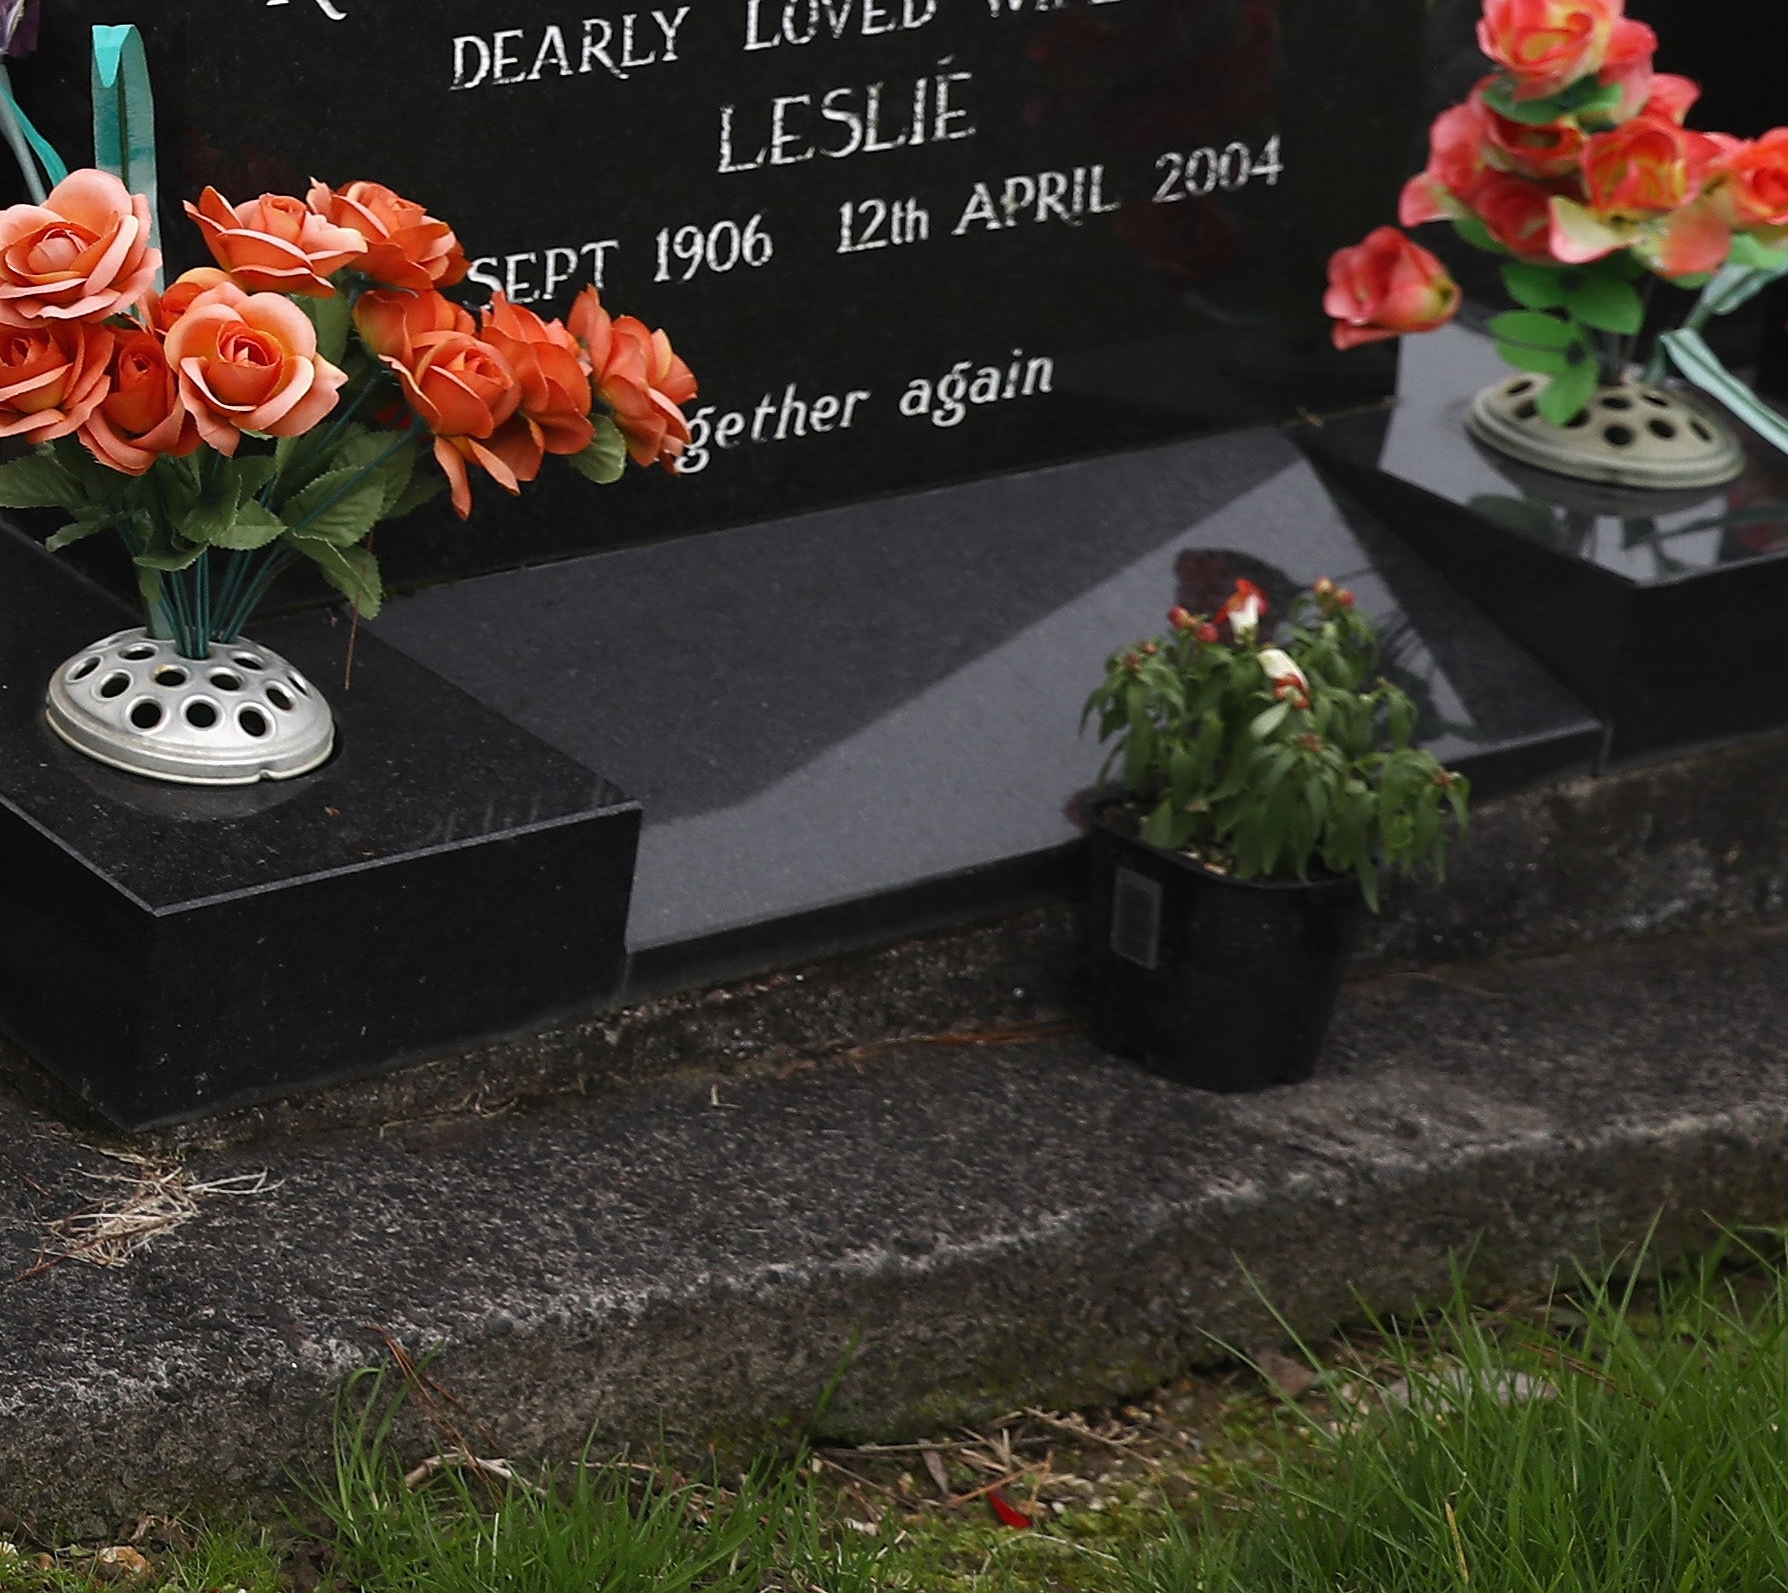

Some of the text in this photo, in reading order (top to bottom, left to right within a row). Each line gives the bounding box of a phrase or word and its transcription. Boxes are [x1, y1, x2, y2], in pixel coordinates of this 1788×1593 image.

[453, 7, 690, 88] DEARLY
[466, 136, 1283, 310] SEPT 1906 12th APRIL 2004
[675, 350, 1054, 473] gether again
